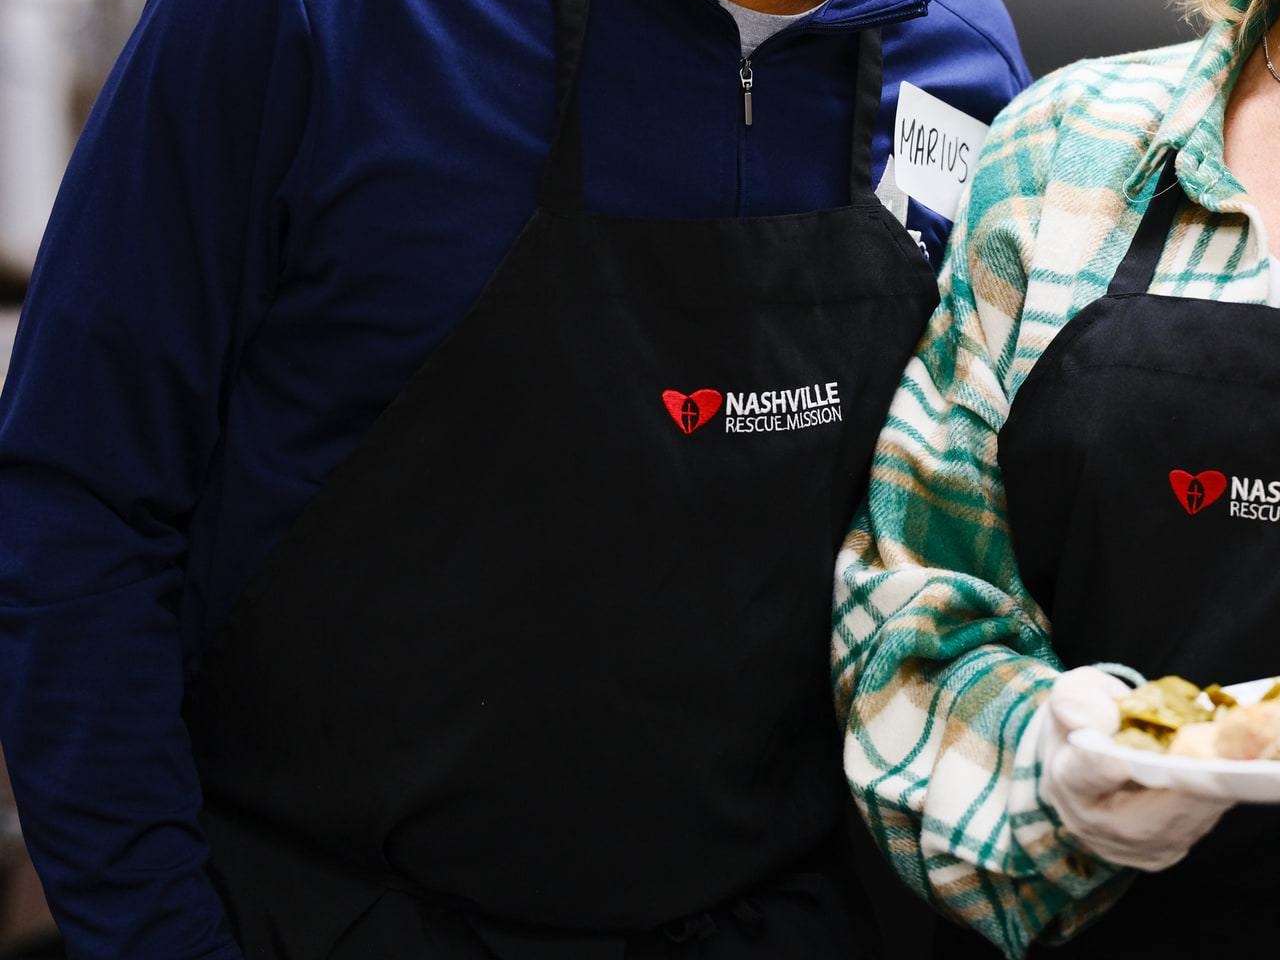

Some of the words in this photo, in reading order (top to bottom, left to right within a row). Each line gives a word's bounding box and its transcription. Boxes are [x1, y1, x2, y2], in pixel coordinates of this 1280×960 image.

[900, 118, 969, 183] MARIUS
[725, 382, 841, 416] NASHVILLE
[725, 415, 782, 433] RESCUE
[786, 405, 843, 431] MISSION
